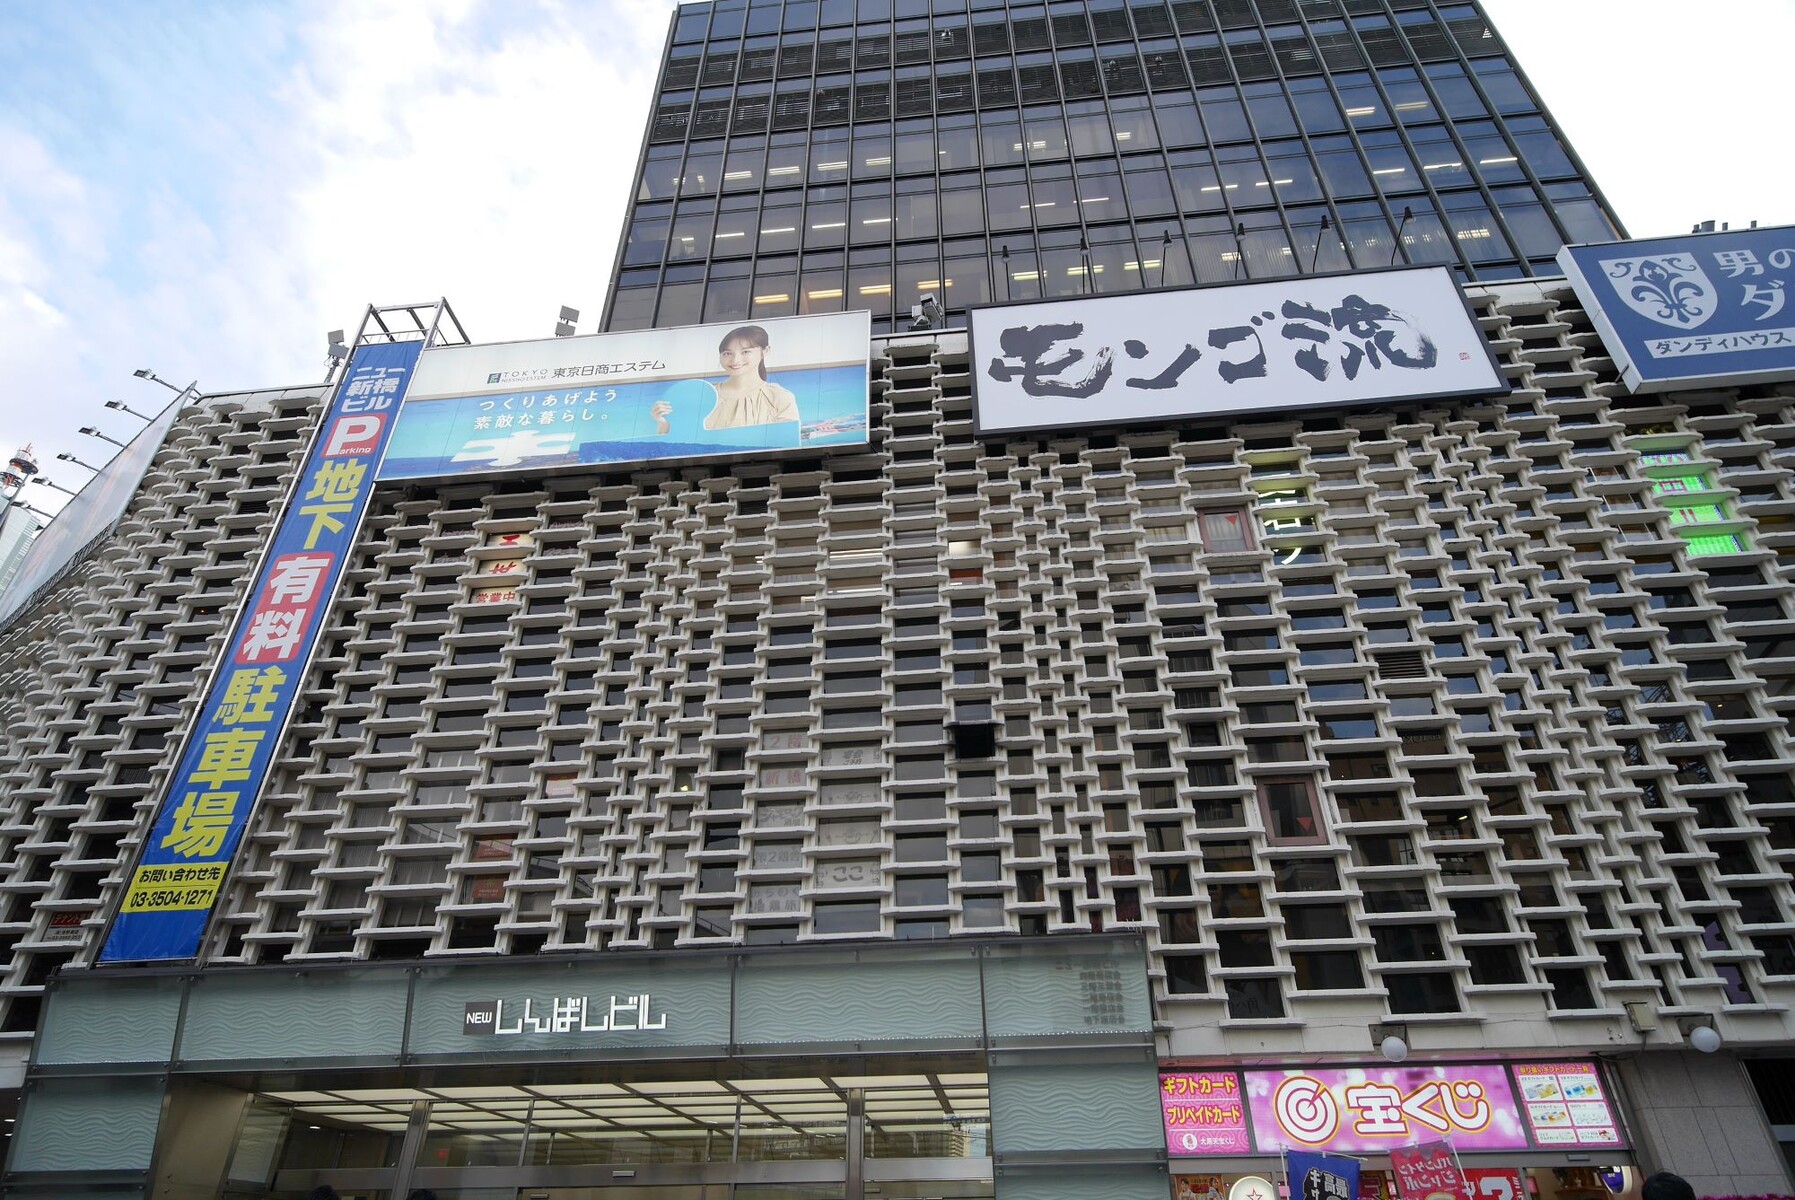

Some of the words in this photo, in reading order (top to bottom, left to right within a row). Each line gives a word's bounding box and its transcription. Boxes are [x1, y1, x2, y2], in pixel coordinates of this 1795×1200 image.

[1740, 279, 1786, 321] ダ
[987, 294, 1438, 399] モンゴ流
[1655, 331, 1792, 355] ダンディハウス
[351, 366, 406, 382] ニュー
[503, 368, 549, 379] TOKYO
[551, 360, 666, 379] 東京日商エステム
[345, 377, 400, 397] 新橋
[341, 395, 393, 412] ビル
[479, 389, 618, 411] つくりあげよう
[473, 411, 609, 431] 素敵な暮らし。
[477, 591, 516, 603] 営業中
[139, 867, 221, 883] お問い合わせ先
[832, 866, 864, 883] ここ
[466, 1011, 493, 1025] NEW
[494, 994, 667, 1035] しんばしビル
[1163, 1076, 1236, 1095] ギフトカード
[1166, 1105, 1241, 1125] プリペイドカード
[1346, 1082, 1491, 1135] 宝くじ
